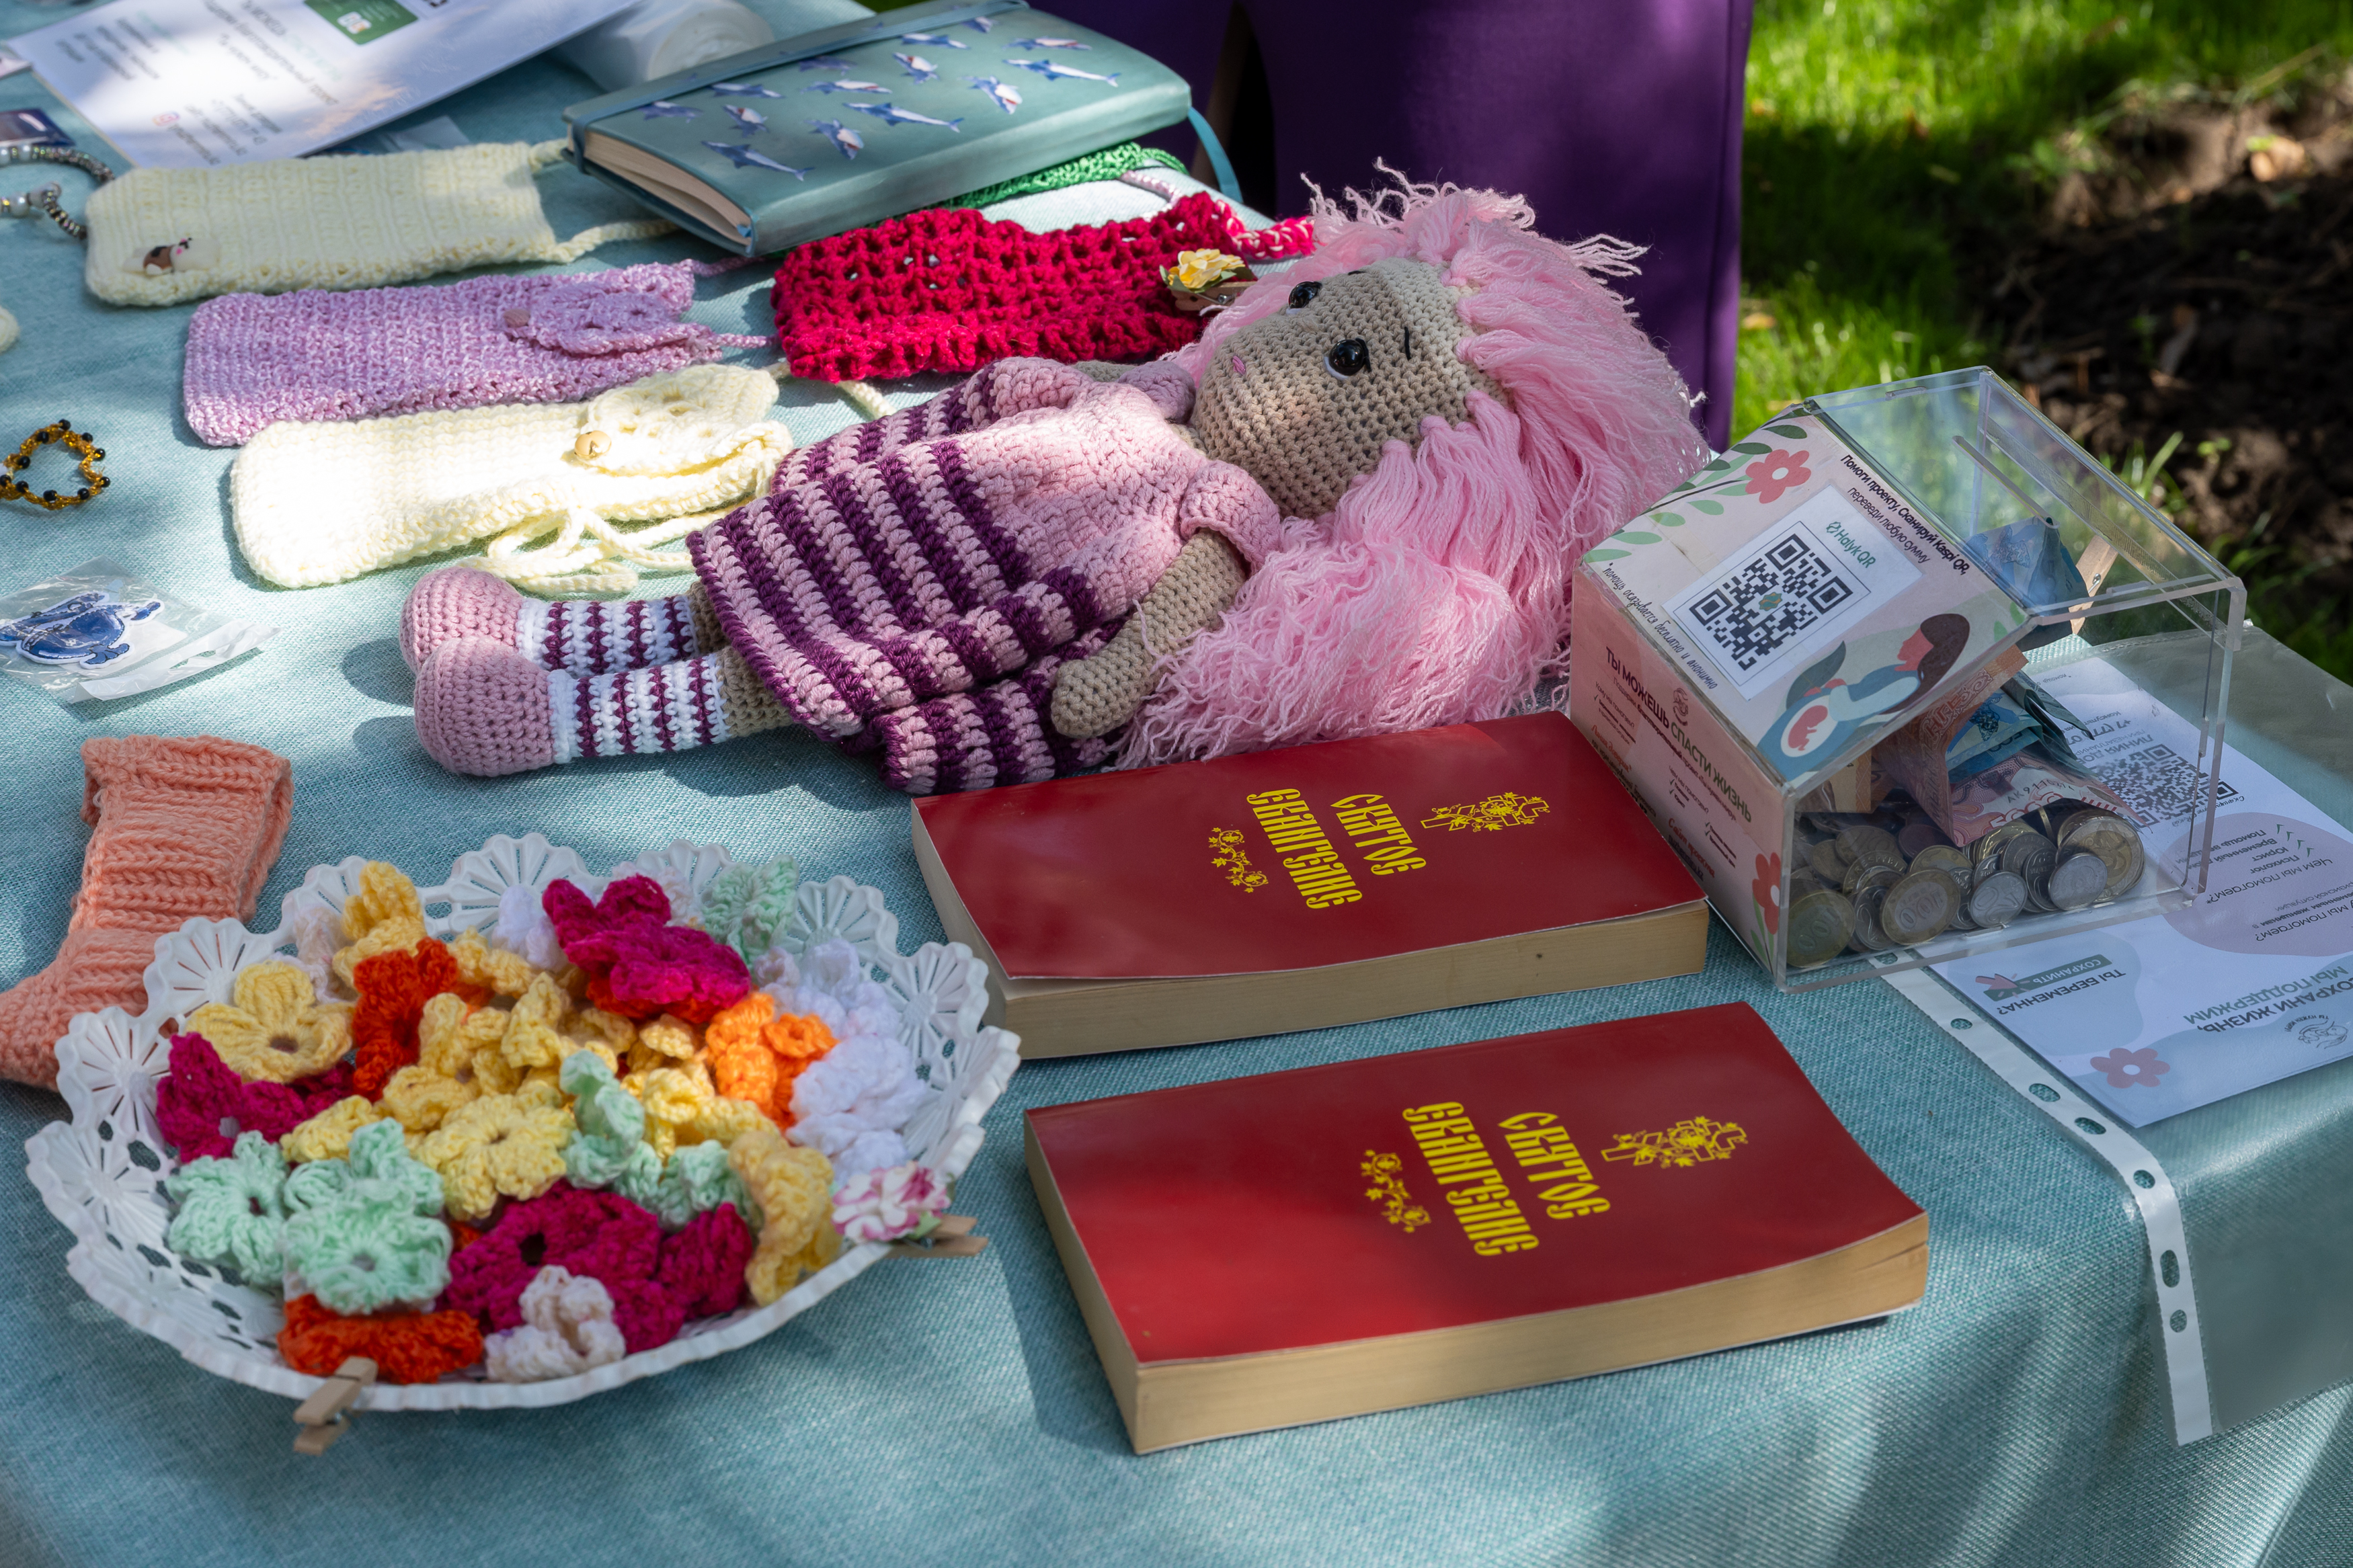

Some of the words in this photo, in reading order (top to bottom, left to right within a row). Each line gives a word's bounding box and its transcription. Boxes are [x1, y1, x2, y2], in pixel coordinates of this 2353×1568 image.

[1840, 454, 1872, 483] Помоги
[1866, 481, 1901, 511] проекту,
[1897, 507, 1940, 544] Сканируй
[1932, 539, 1960, 560] Kaspi
[1953, 559, 1970, 576] QR,
[1847, 487, 1884, 522] переведи
[1879, 518, 1907, 543] любую
[1904, 540, 1931, 565] сумму
[1834, 529, 1862, 556] Halyk
[1857, 551, 1876, 569] QR
[1623, 589, 1659, 624] оказывается
[1654, 620, 1685, 653] бесплатно
[1686, 659, 1718, 690] анонимно
[1612, 702, 1635, 729] помогаем?
[2116, 720, 2131, 729] +7
[1591, 725, 1609, 748] Линия
[1605, 646, 1621, 675] ТЫ
[1622, 665, 1670, 729] МОЖЕШЬ
[1671, 721, 1712, 774] СПАСТИ
[1712, 767, 1752, 823] ЖИЗНЬ
[2081, 723, 2115, 738] (77)
[2077, 733, 2132, 755] НЕЗАПЛАНИР
[2104, 734, 2154, 754] ЛИНИЯ
[1685, 784, 1710, 815] помогаем?
[2196, 795, 2245, 817] Сканируте
[1246, 788, 1363, 909] ЕВАНГЕЛИЕ
[1668, 817, 1687, 845] Сайт
[1687, 842, 1715, 879] проекта
[2221, 829, 2267, 846] Помощь
[2213, 838, 2278, 864] Временный
[2251, 846, 2289, 862] Юрист
[2250, 854, 2301, 874] Психолог
[2281, 866, 2303, 878] мы
[2302, 858, 2334, 870] Чем
[2311, 891, 2353, 910] еменным
[2313, 881, 2353, 899] ризисной
[2275, 897, 2315, 912] ситуации
[2327, 904, 2350, 917] мы
[2255, 911, 2327, 942] помогаем?
[2260, 907, 2311, 927] женщинам
[2032, 958, 2102, 985] СОХРАНИТЬ
[2098, 968, 2126, 982] ТЫ
[2309, 966, 2350, 984] МЫ
[1997, 977, 2100, 1016] БЕРЕМЕННА?
[2183, 978, 2313, 1025] ПОДДЕРЖИМ
[2197, 1005, 2278, 1033] ЖИЗНЬ,
[1402, 1102, 1540, 1256] ЕВАНГЕЛИЕ
